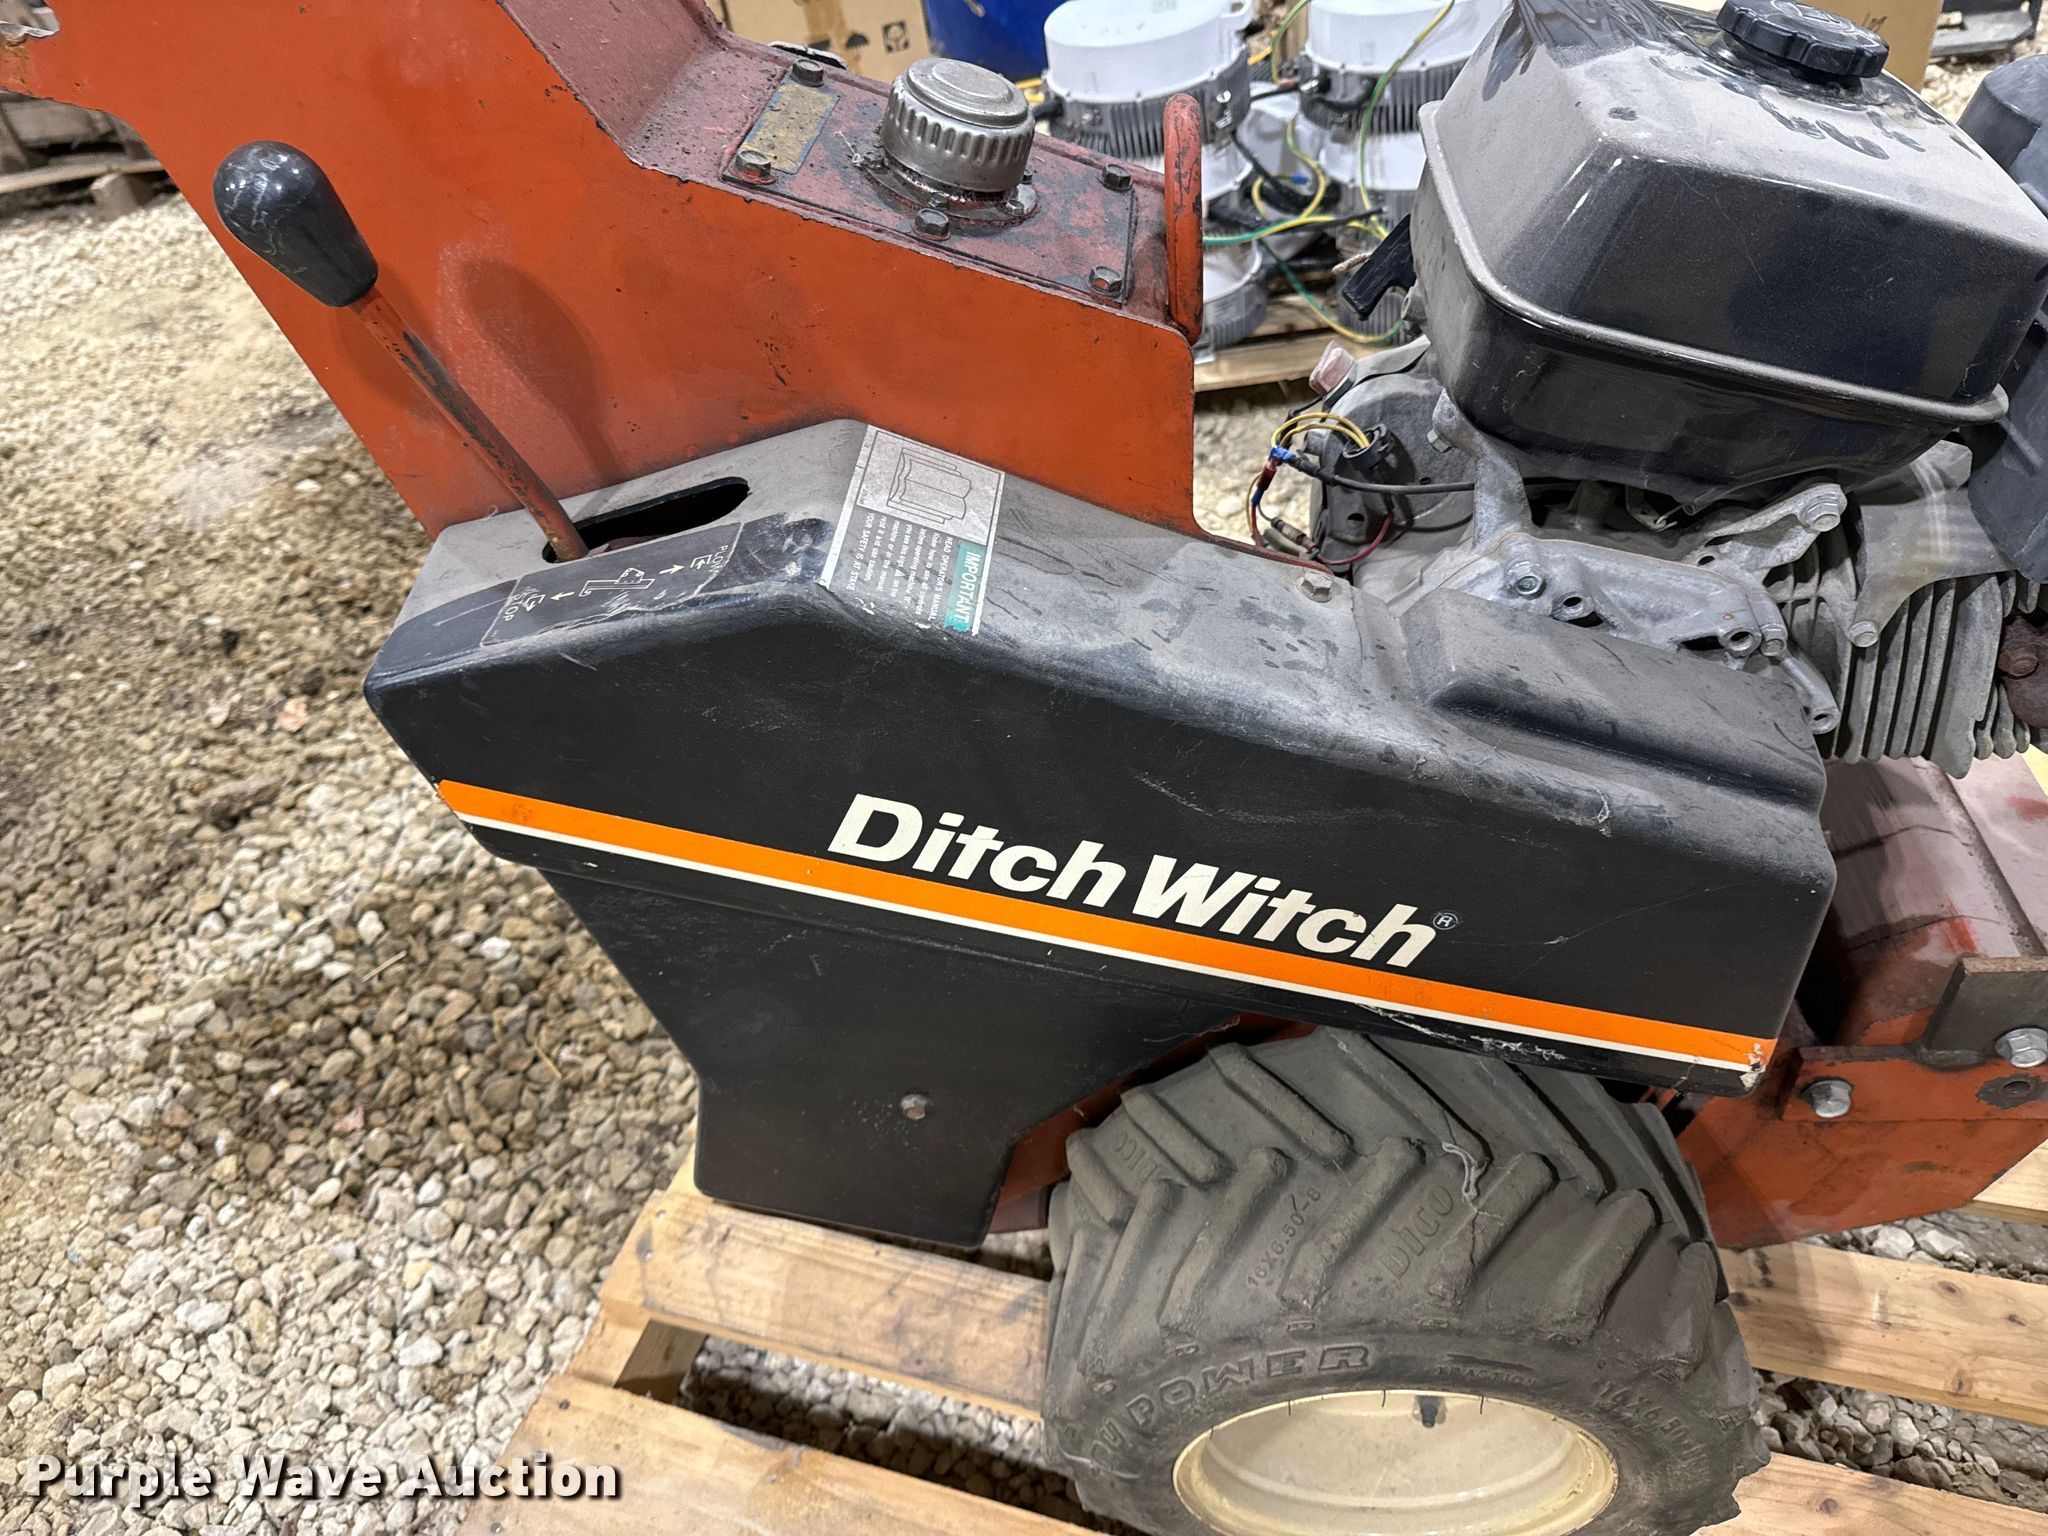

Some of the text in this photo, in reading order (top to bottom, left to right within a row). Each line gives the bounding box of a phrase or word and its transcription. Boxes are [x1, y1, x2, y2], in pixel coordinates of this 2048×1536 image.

[890, 520, 901, 542] machine
[905, 523, 913, 534] you
[917, 528, 927, 545] before
[858, 529, 870, 552] SAFETY
[931, 532, 940, 548] Know
[944, 536, 953, 553] READ
[708, 544, 729, 574] PLOW
[853, 561, 861, 570] AT
[883, 559, 891, 569] the
[910, 544, 923, 571] operating
[928, 549, 936, 561] how
[954, 551, 981, 622] IMPORTANT
[503, 594, 525, 621] STOP
[827, 793, 1126, 907] Ditch
[1382, 1182, 1455, 1280] DICO
[1125, 1342, 1370, 1426] POWER
